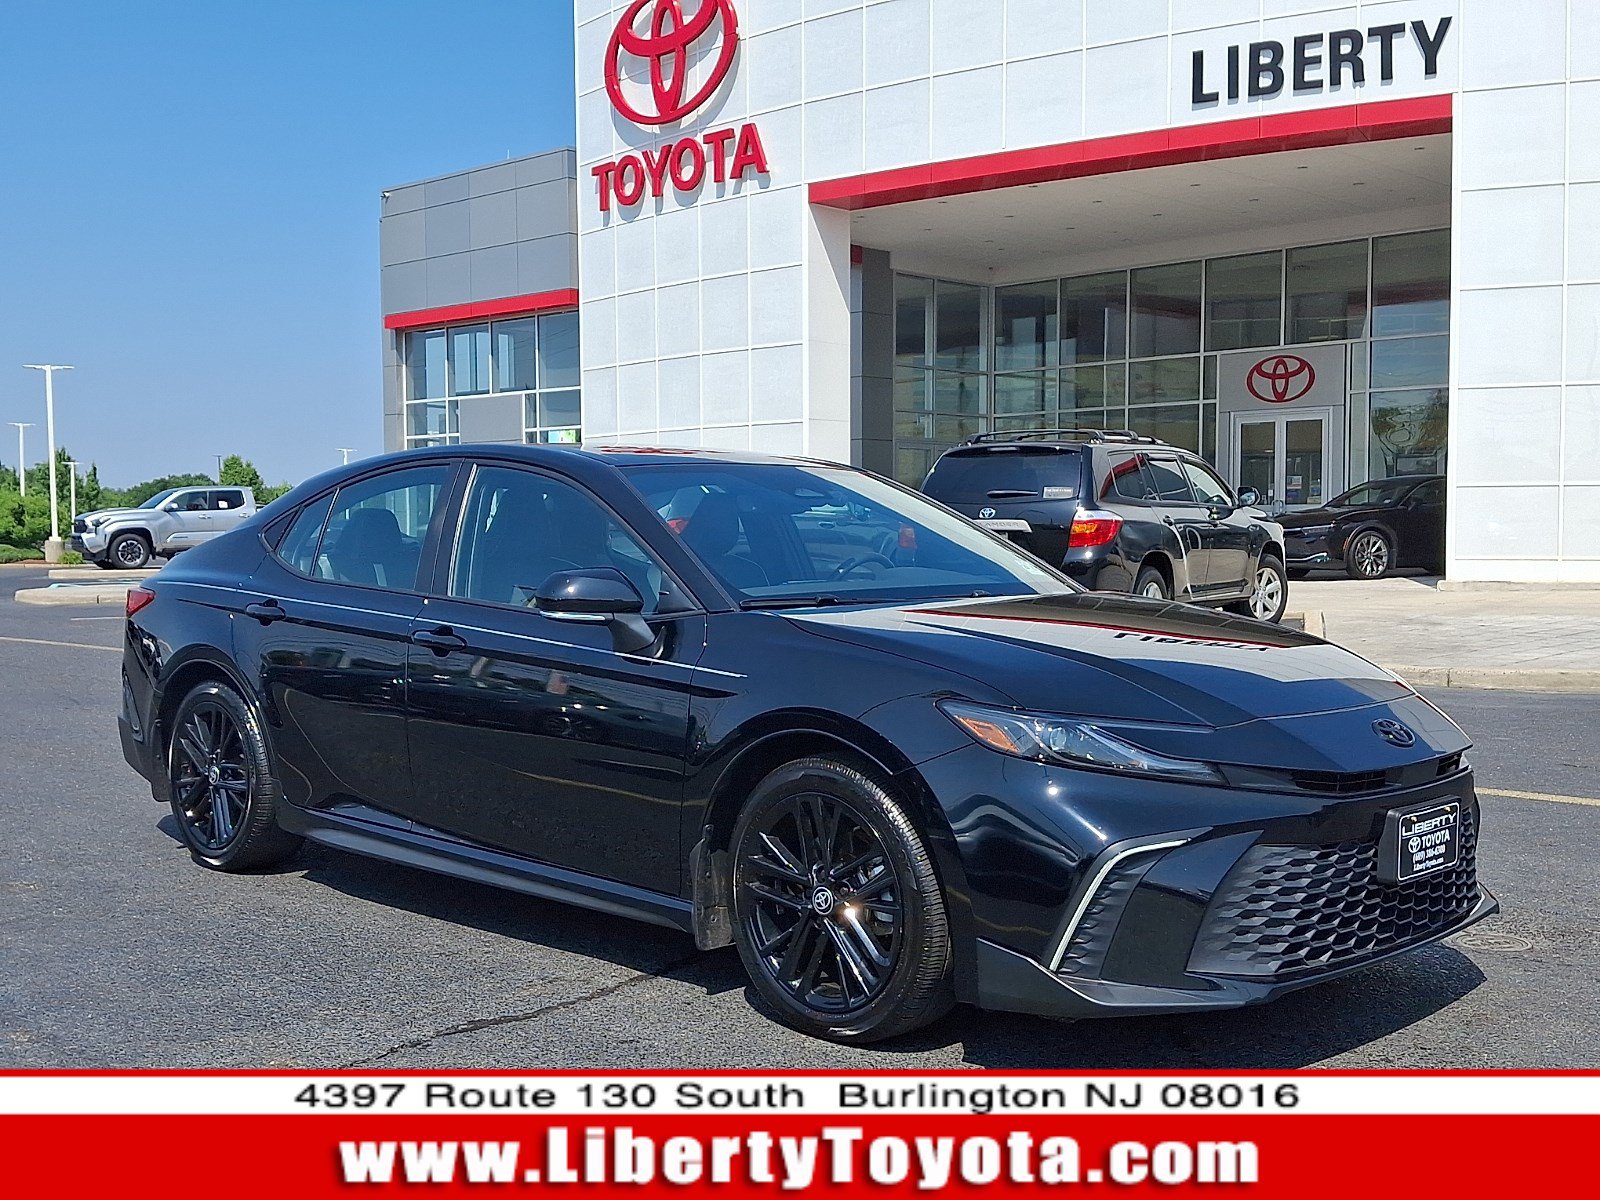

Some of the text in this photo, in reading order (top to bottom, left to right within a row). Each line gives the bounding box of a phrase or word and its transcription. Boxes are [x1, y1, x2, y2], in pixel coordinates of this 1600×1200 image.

[1192, 17, 1453, 104] LIBERTY
[592, 123, 769, 211] TOYOTA
[1402, 812, 1456, 836] LIBERTY
[1422, 829, 1450, 848] TOYOTA
